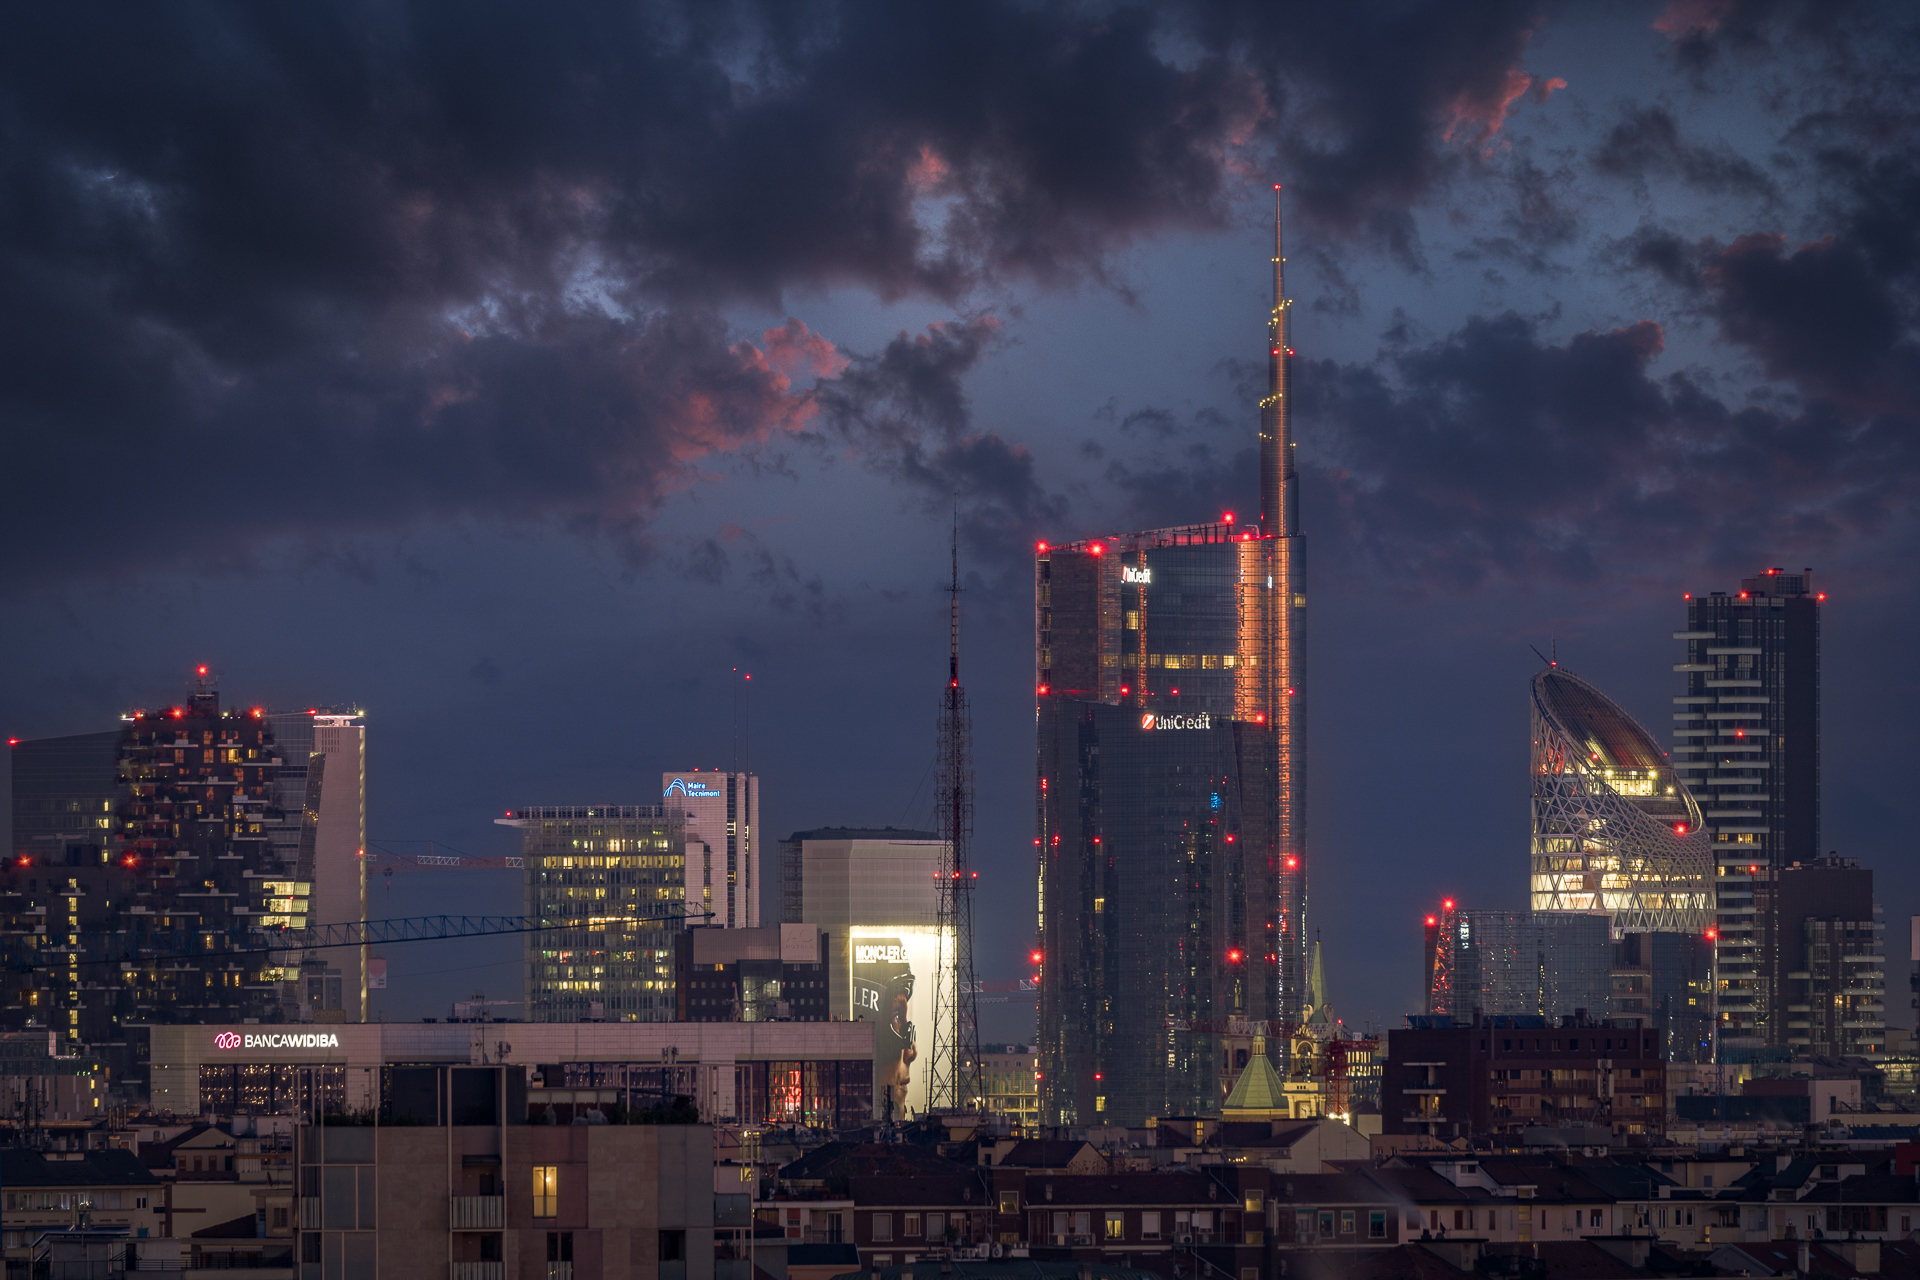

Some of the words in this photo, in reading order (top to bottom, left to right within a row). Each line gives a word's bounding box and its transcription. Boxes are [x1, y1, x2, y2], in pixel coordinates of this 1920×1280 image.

[1156, 714, 1211, 730] UniCredit
[855, 945, 900, 960] MONCLER
[244, 1034, 339, 1048] BANCAWIDIBA
